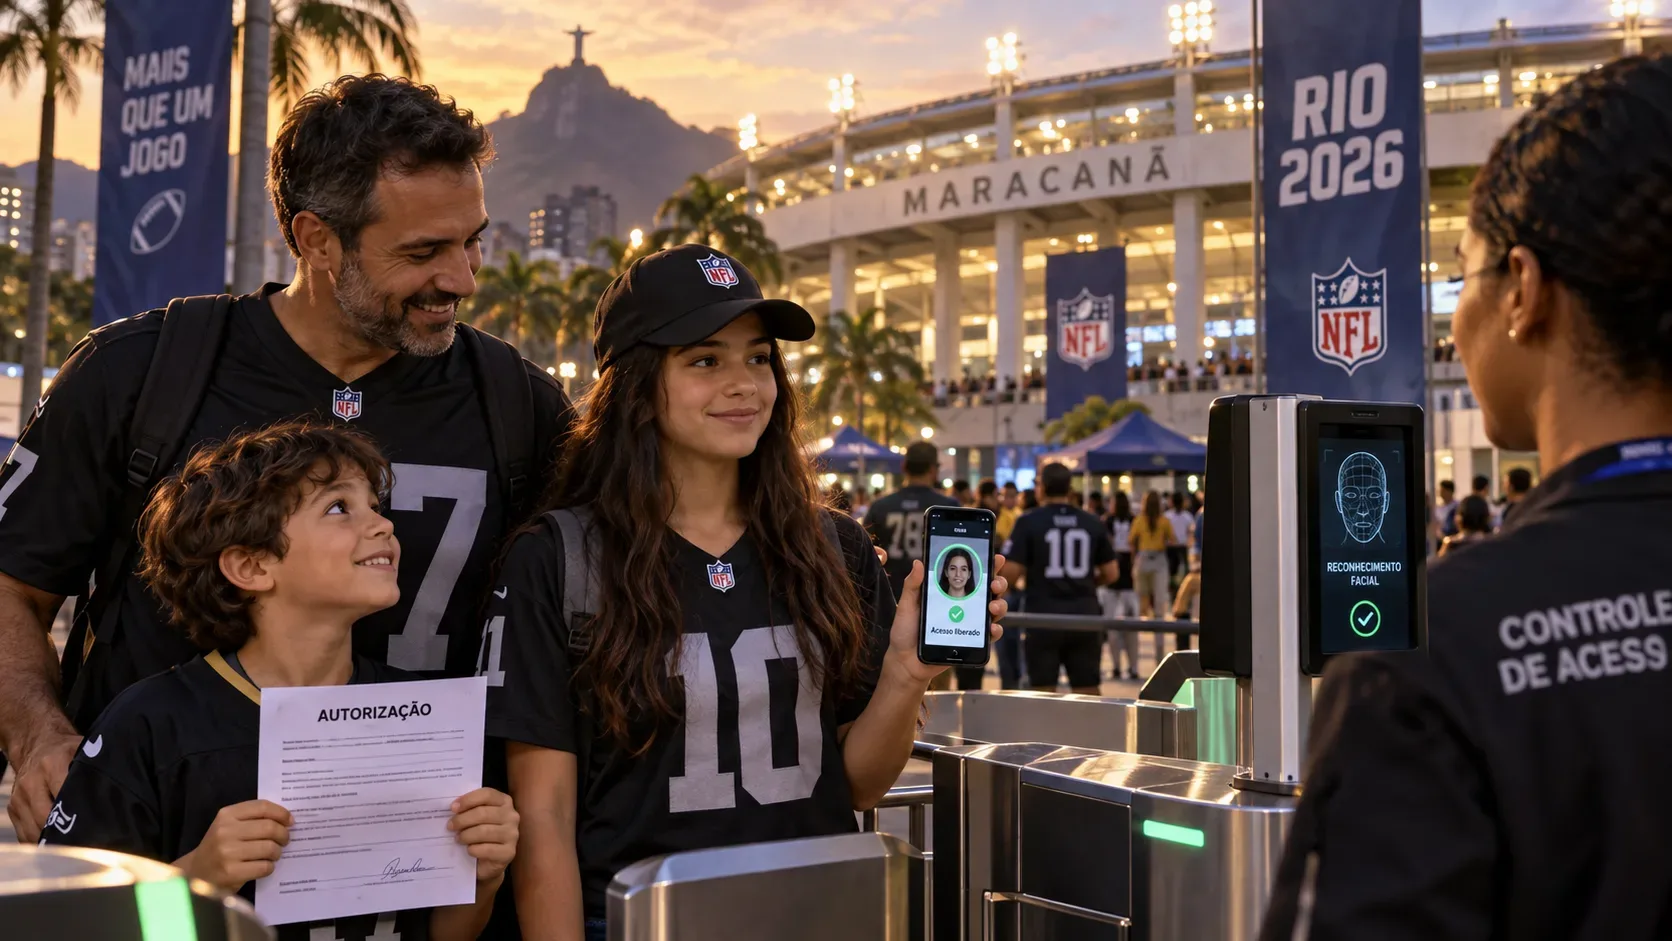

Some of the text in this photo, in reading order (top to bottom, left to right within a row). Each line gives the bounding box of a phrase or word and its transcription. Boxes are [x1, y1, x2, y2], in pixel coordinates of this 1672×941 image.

[121, 83, 215, 137] QUE UM
[1291, 62, 1388, 142] RIO
[120, 131, 187, 178] JOGO
[1278, 128, 1405, 208] 2026
[903, 146, 1170, 217] MARACANÃ
[707, 268, 736, 283] NFL
[1065, 323, 1107, 358] NFL
[1320, 309, 1379, 360] NFL
[337, 401, 359, 416] NFL
[886, 512, 924, 559] 78
[1044, 527, 1091, 579] 10
[386, 462, 488, 671] 7
[1326, 561, 1403, 573] RECONHECIMENTO
[1350, 575, 1380, 586] FACIAL
[954, 627, 981, 637] liberado
[1498, 589, 1672, 651] CONTROLE
[1497, 655, 1552, 696] DE
[317, 700, 432, 722] AUTORIZAÇÃO
[664, 624, 825, 814] 10
